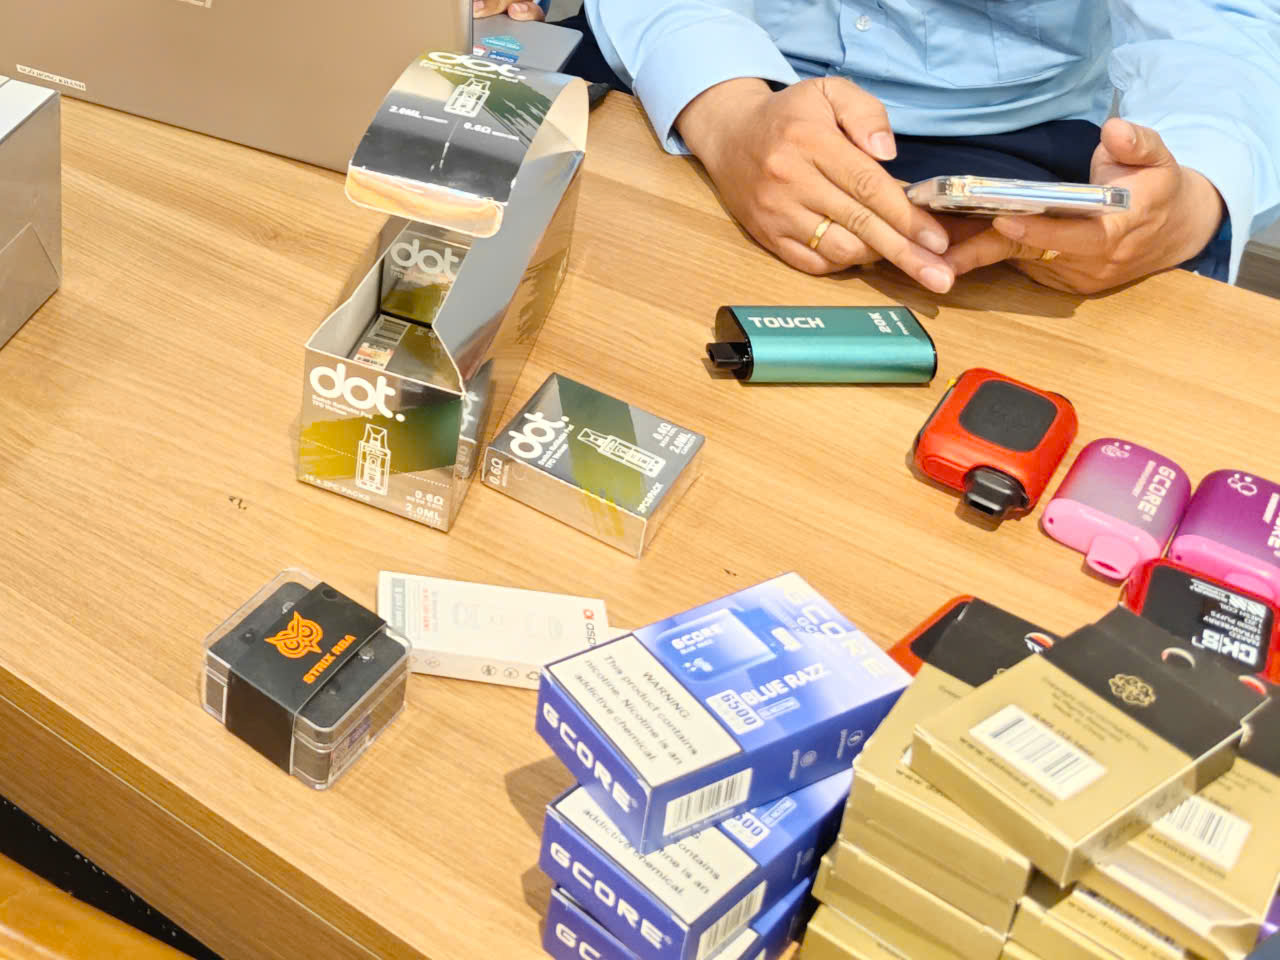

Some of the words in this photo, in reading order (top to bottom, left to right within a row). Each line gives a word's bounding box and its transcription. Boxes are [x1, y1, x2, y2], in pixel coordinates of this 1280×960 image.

[747, 316, 825, 329] TOUCH
[309, 363, 406, 422] dot.
[509, 412, 570, 459] dot.
[1137, 465, 1176, 517] GCORE
[303, 653, 336, 684] STRIX
[740, 678, 788, 707] BLUE
[784, 663, 832, 689] RAZZ
[575, 674, 614, 715] addictive
[604, 655, 622, 675] This
[621, 676, 659, 712] product
[657, 711, 698, 755] contains
[642, 672, 690, 719] WARNING
[721, 692, 758, 726] 6500
[624, 698, 658, 738] Nicotine
[668, 751, 683, 765] an
[543, 702, 630, 813] GCORE
[550, 842, 663, 949] GCORE
